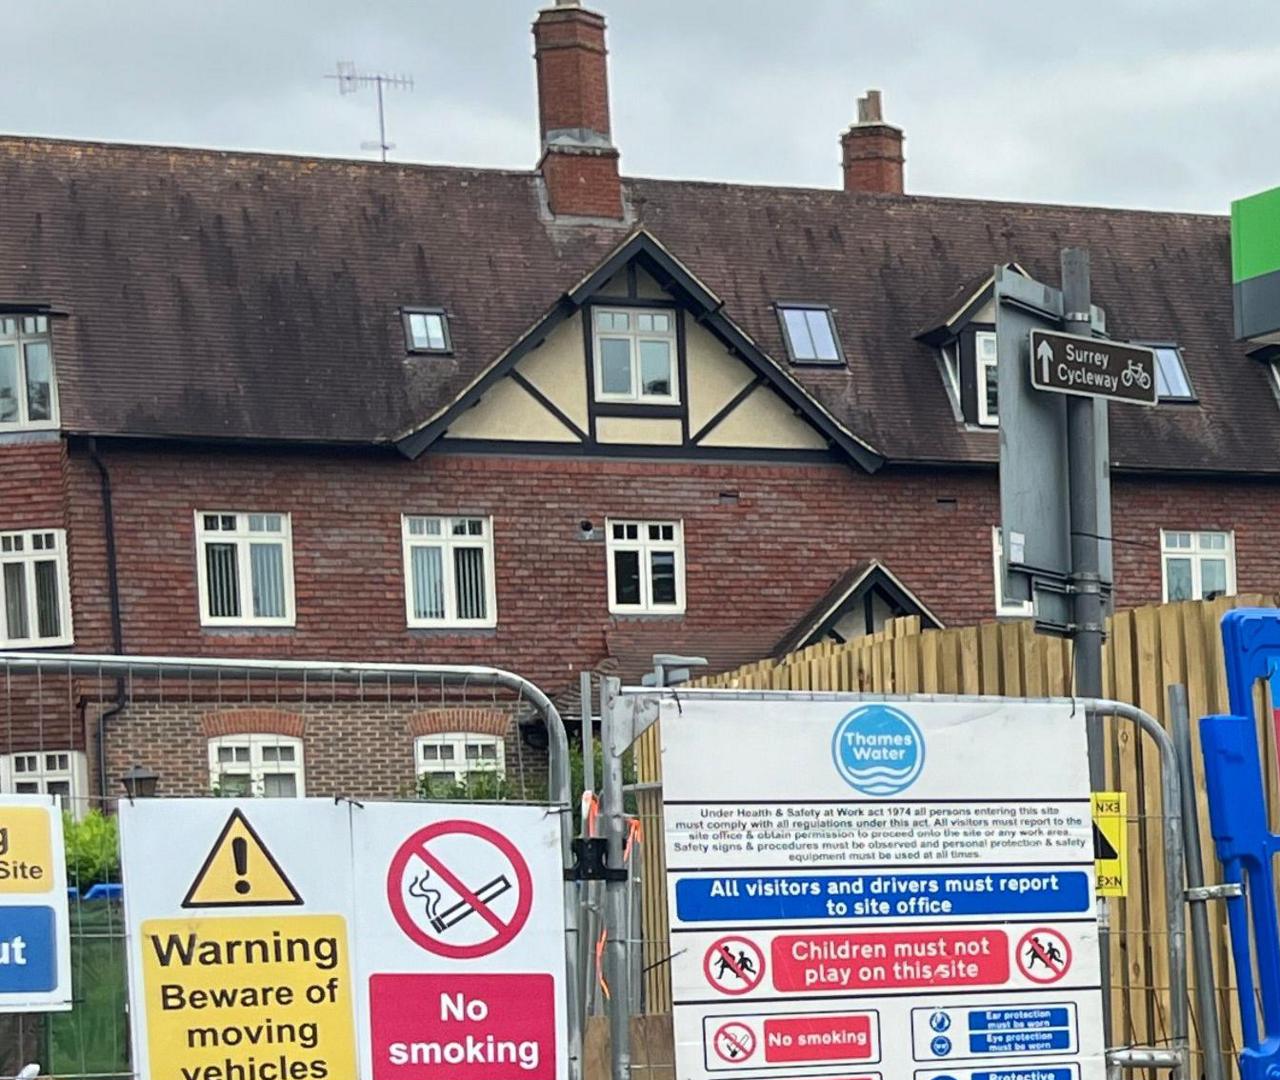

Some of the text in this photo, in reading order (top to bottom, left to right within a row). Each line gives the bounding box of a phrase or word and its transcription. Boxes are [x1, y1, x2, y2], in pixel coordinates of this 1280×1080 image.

[1066, 344, 1109, 369] Surrey
[1057, 364, 1118, 391] Cycleway
[845, 732, 912, 747] Thames
[853, 746, 906, 762] Water
[676, 820, 705, 830] must
[707, 820, 747, 832] comply
[751, 819, 773, 828] with
[777, 819, 789, 828] all
[792, 818, 853, 830] regulations
[856, 818, 886, 827] under
[889, 818, 910, 827] this
[934, 817, 948, 826] All
[951, 817, 990, 827] visitors
[992, 817, 1017, 826] must
[1020, 817, 1051, 828] report
[1054, 817, 1063, 826] to
[1066, 816, 1082, 826] the
[700, 806, 1059, 819] Under Health & Safety at Work act 1974 all persons entering this site
[0, 860, 44, 880] Site
[711, 875, 1058, 897] All visitors and drivers must report
[826, 897, 952, 916] to site office
[151, 931, 338, 970] Warning
[791, 937, 990, 961] Children must not
[805, 960, 979, 986] play on this site
[161, 978, 338, 1011] Beware of
[439, 993, 488, 1022] No
[187, 1022, 318, 1049] moving
[768, 1028, 868, 1048] No smoking
[388, 1034, 540, 1070] smoking
